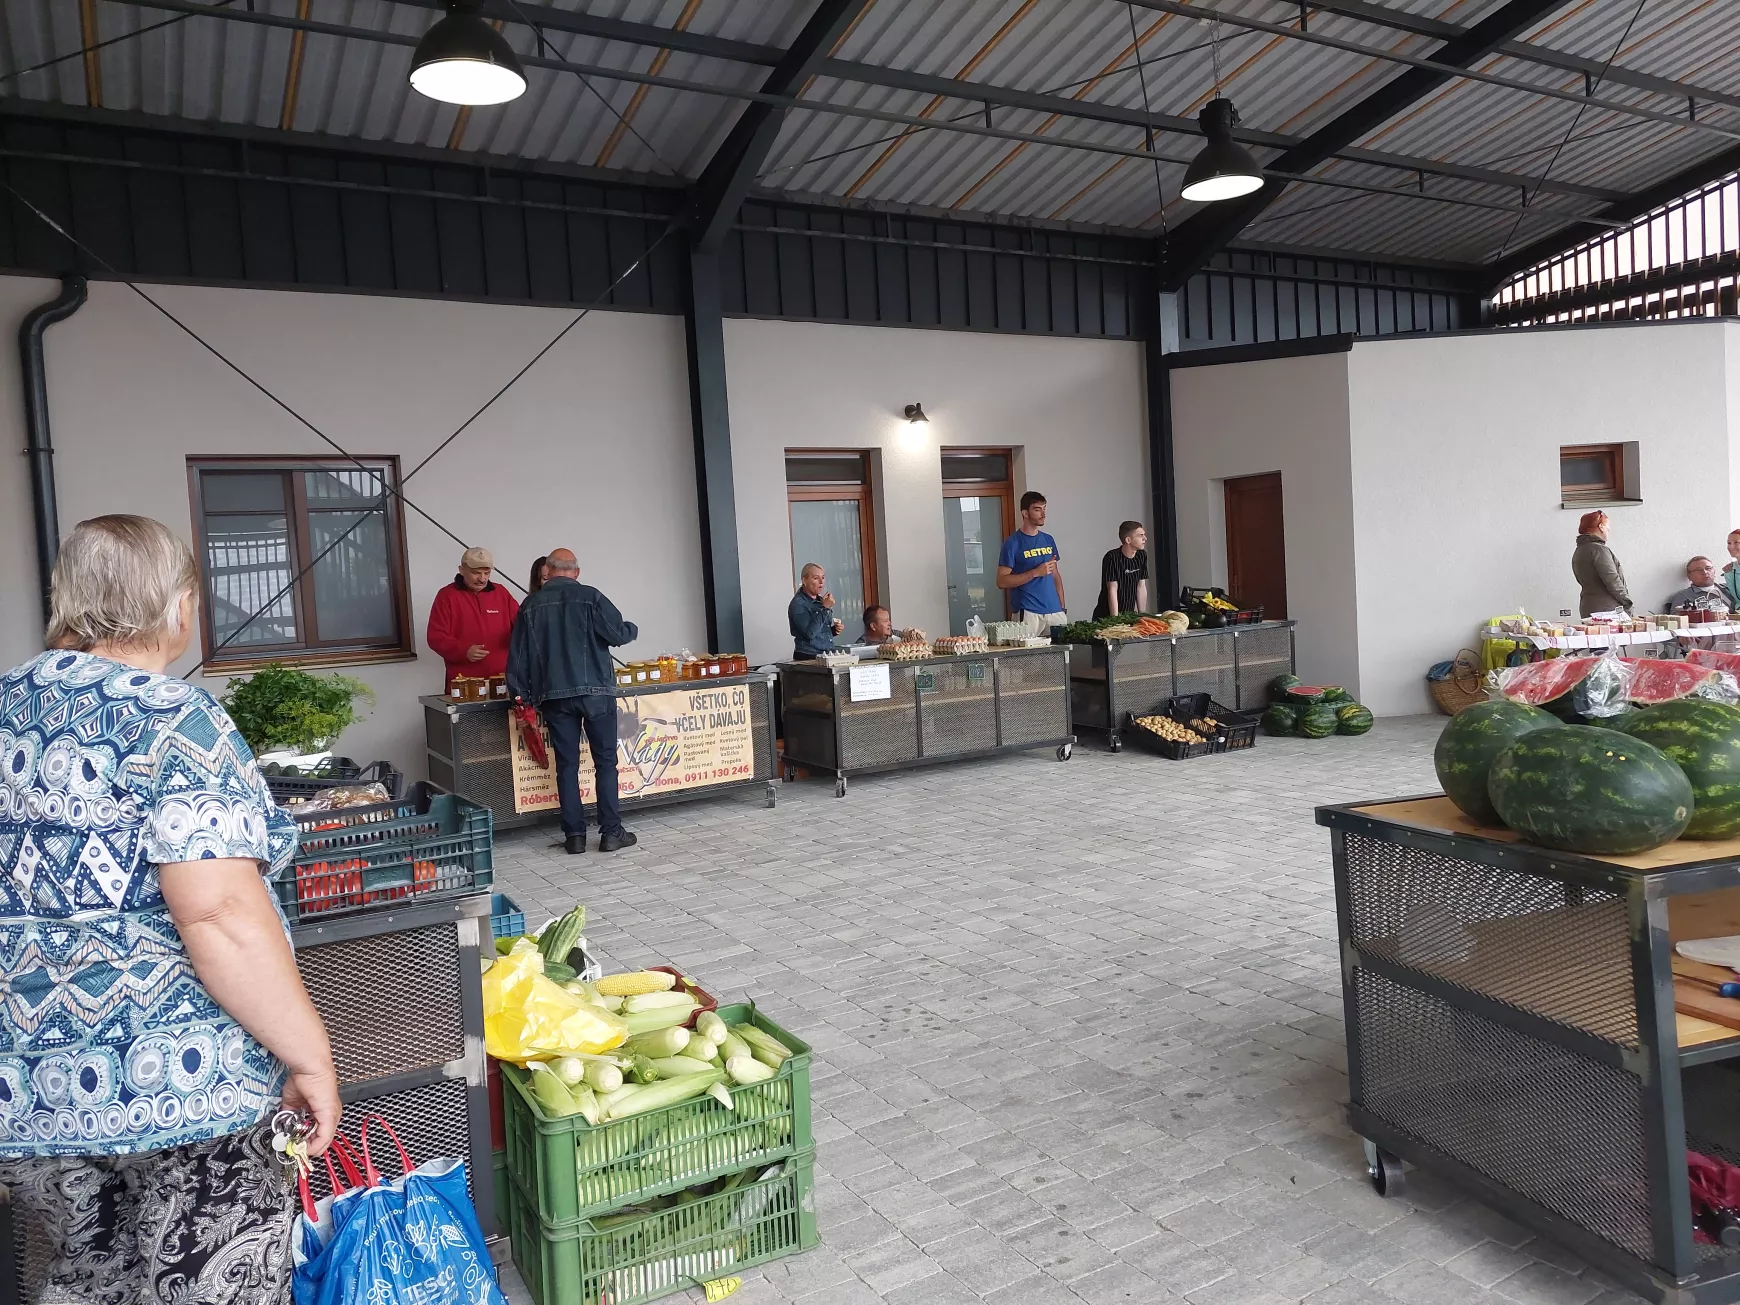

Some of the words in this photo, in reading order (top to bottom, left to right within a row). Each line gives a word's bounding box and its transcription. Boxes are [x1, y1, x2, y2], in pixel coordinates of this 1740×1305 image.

[1023, 547, 1052, 558] RETRO
[689, 692, 730, 711] VŠETKO,
[732, 688, 745, 707] ČO
[675, 712, 707, 733] VČELY
[709, 707, 746, 729] DÁVAJÚ
[519, 764, 542, 772] Akácm
[616, 730, 678, 794] Nagy
[519, 773, 551, 782] Krémméz
[684, 771, 708, 783] 0911
[711, 768, 729, 779] 130
[731, 764, 749, 776] 246
[520, 784, 549, 793] Hársméz
[402, 1265, 454, 1301] TESCO
